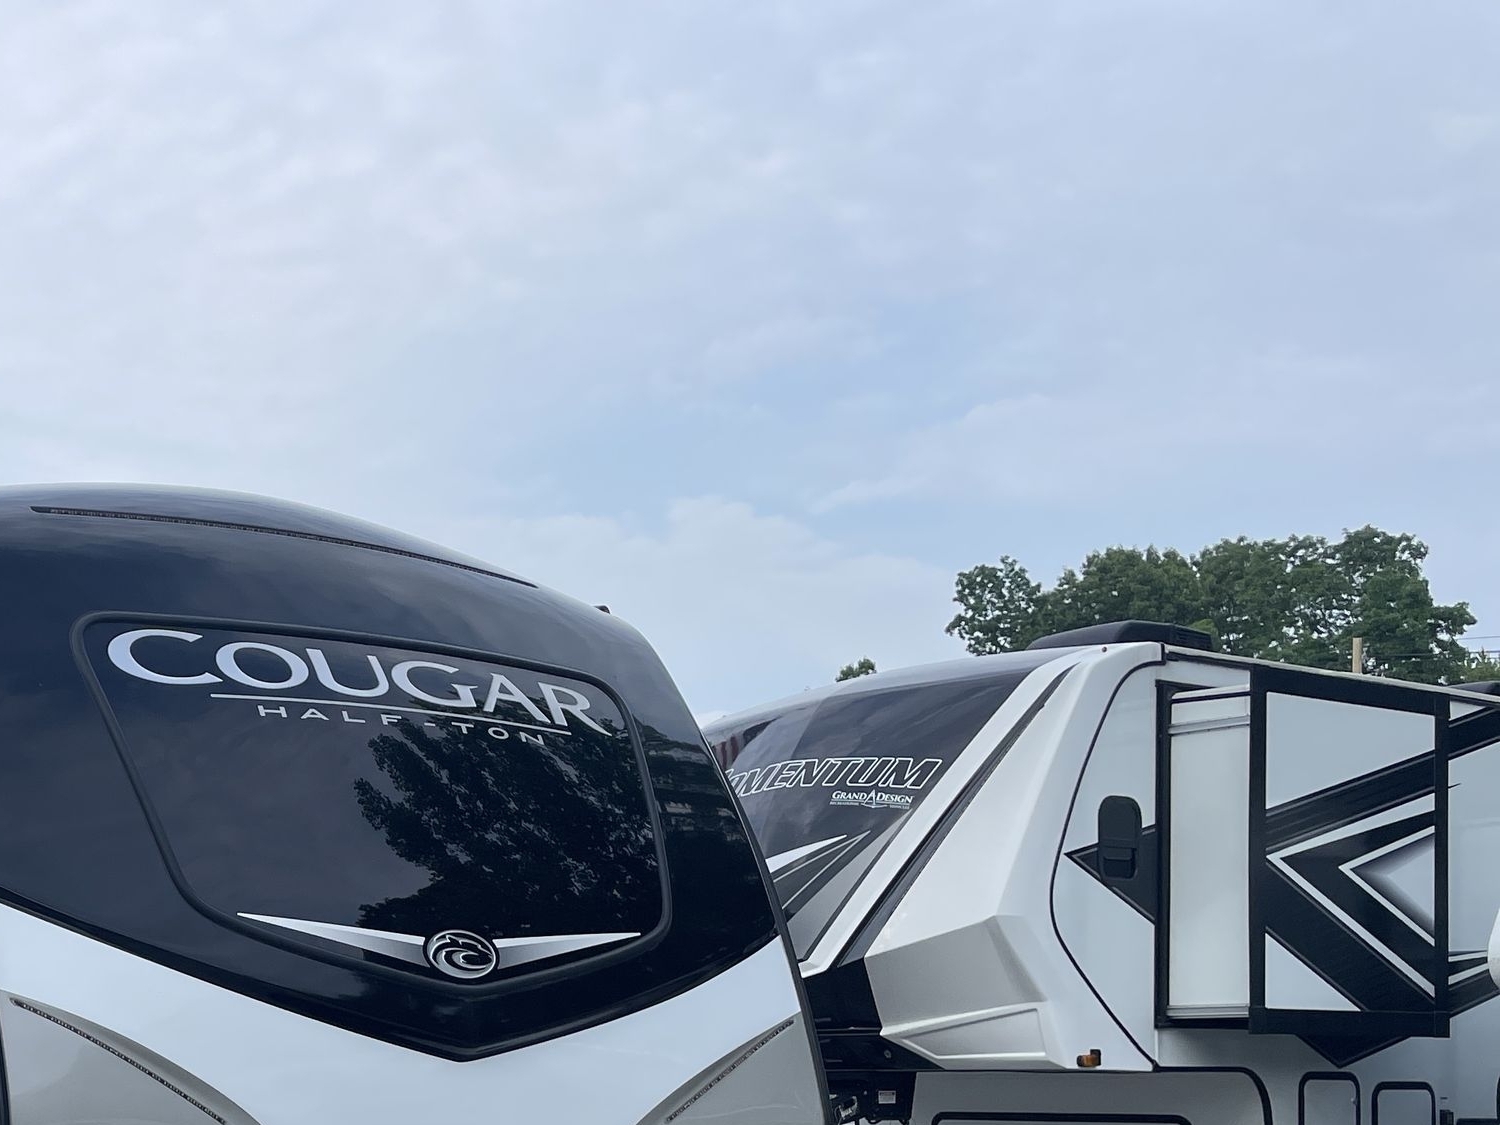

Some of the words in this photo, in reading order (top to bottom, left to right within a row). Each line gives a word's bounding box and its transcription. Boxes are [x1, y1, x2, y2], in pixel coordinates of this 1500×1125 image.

[107, 628, 613, 737] COUGAR
[725, 757, 943, 798] OMENTUM
[831, 790, 868, 800] GRAND
[876, 792, 914, 803] DESIGN
